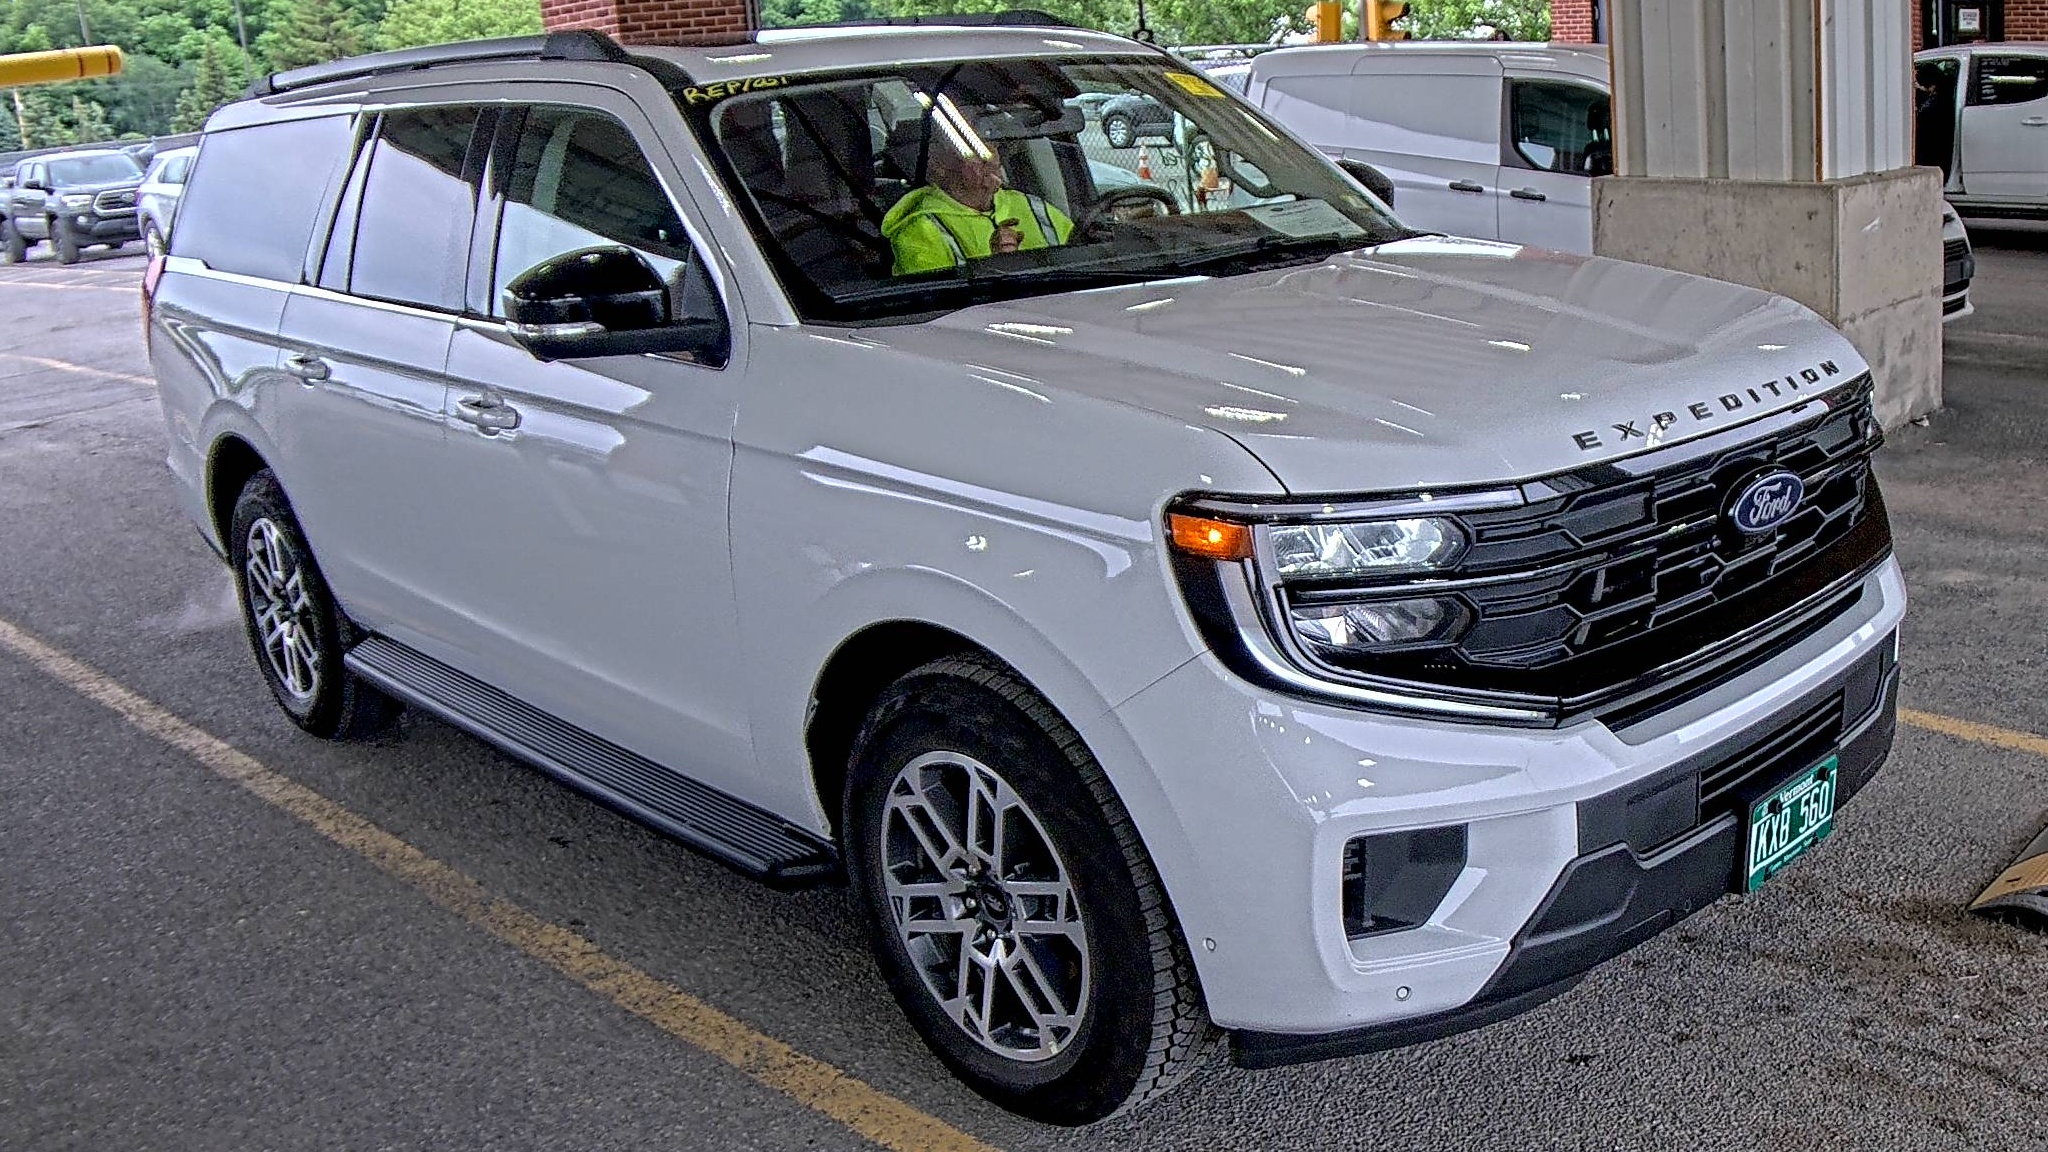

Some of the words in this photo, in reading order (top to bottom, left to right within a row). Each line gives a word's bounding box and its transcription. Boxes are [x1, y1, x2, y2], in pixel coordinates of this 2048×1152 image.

[1571, 360, 1840, 450] EXPEDITION
[1749, 481, 1791, 525] Ford
[1756, 806, 1791, 863] KXB
[1798, 780, 1830, 834] 560
